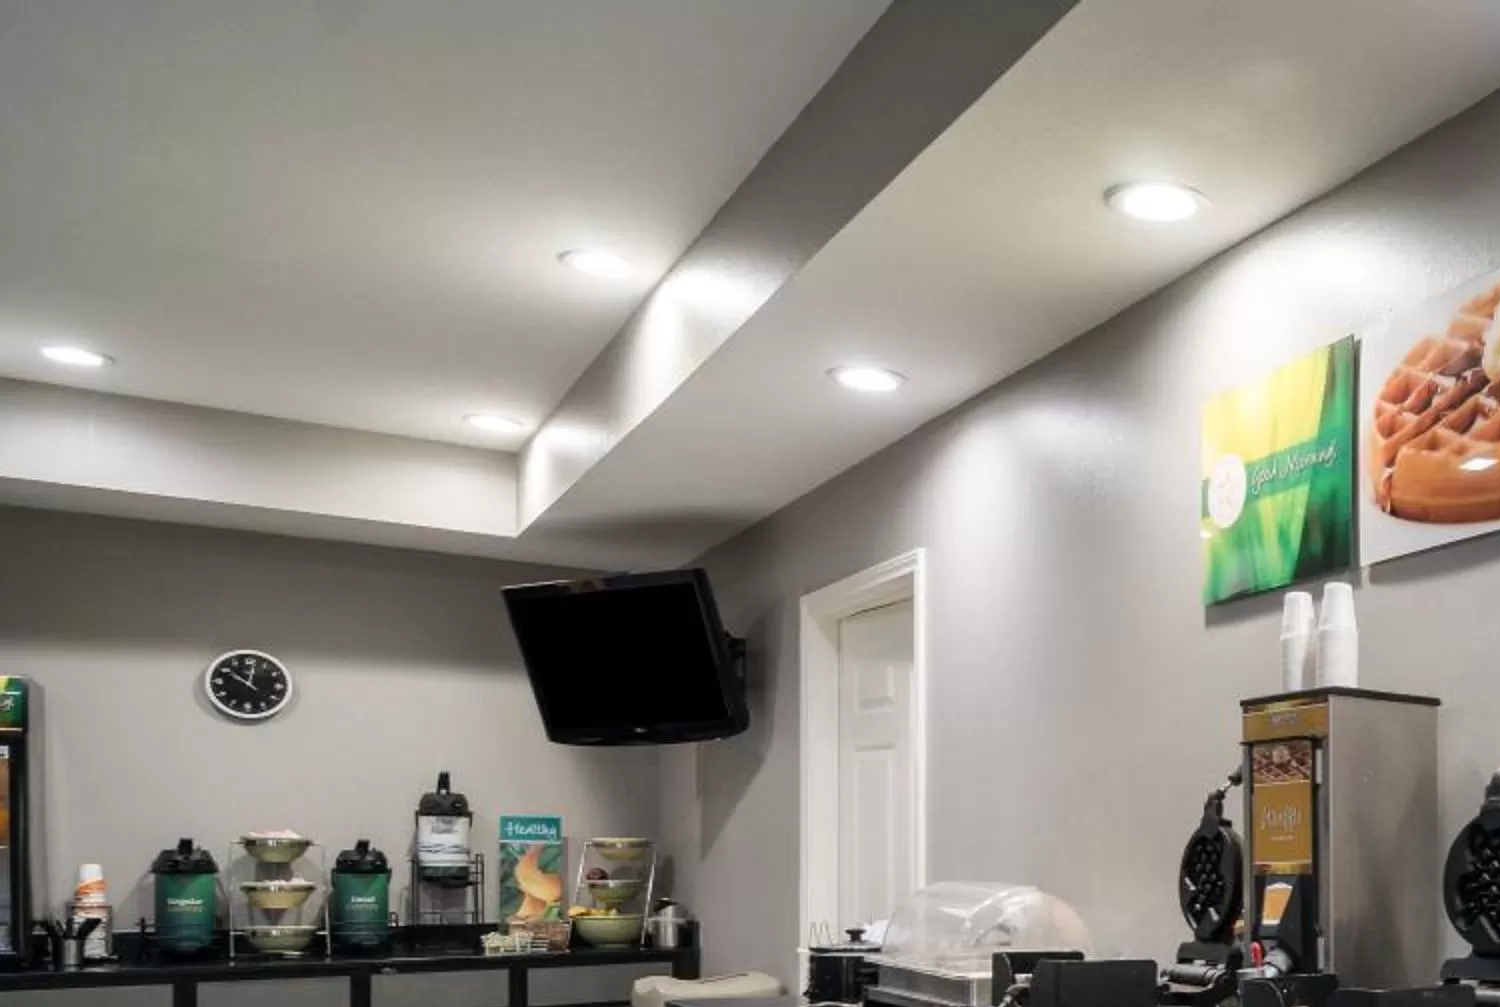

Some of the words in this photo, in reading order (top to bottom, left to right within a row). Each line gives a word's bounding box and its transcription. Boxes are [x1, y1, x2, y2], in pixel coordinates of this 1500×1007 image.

[1252, 458, 1277, 494] Good
[1279, 439, 1337, 480] Morning
[504, 821, 557, 841] Healthy
